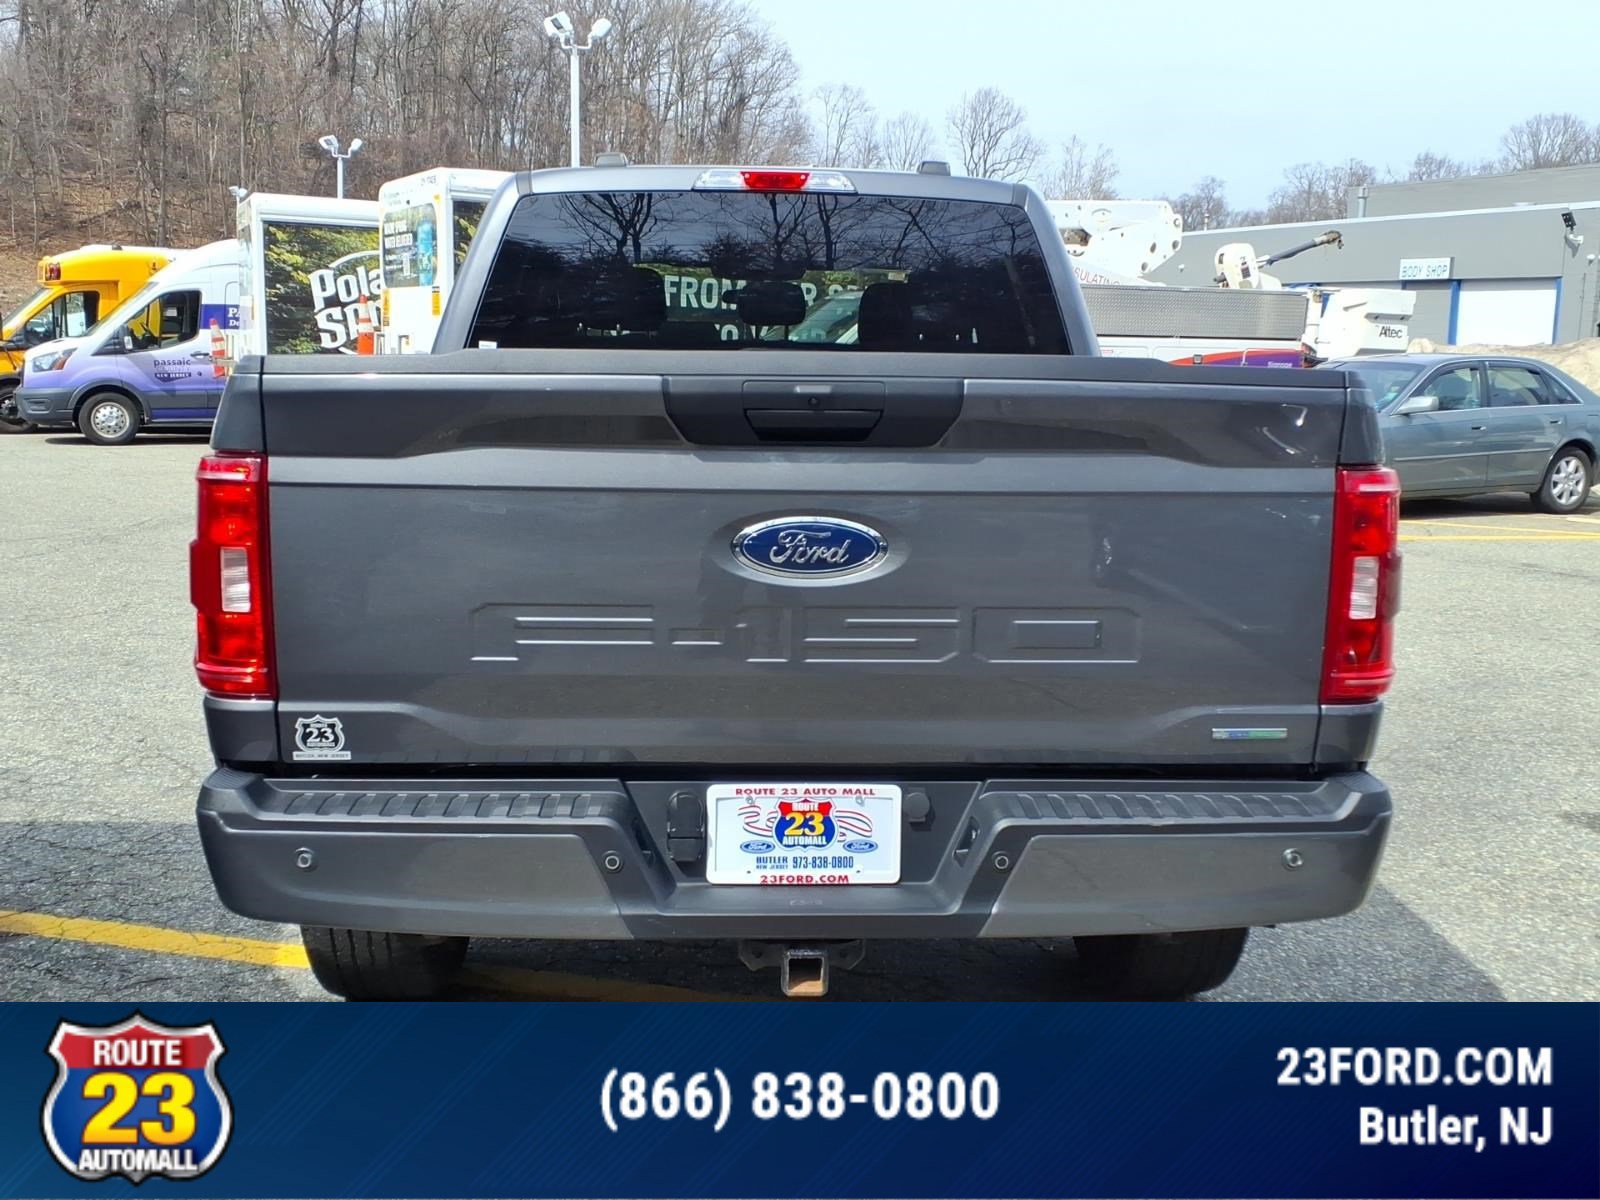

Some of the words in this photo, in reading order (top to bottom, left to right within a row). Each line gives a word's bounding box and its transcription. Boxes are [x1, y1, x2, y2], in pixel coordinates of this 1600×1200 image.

[1401, 265, 1423, 278] BODY
[1426, 264, 1448, 277] SHOP
[1379, 326, 1403, 339] Altec
[153, 357, 192, 367] passaic
[769, 529, 852, 564] Ford
[470, 603, 1142, 664] F-150
[305, 727, 335, 743] 23
[736, 788, 776, 796] ROUTE
[781, 788, 798, 796] 23
[803, 788, 837, 796] AUTO
[842, 788, 876, 796] MALL
[792, 802, 819, 812] ROUTE
[784, 811, 825, 836] 23
[782, 835, 827, 846] AUTOMALL
[756, 856, 788, 864] BUTLER
[792, 856, 854, 869] 973-838-0800
[760, 875, 849, 885] 23FORD.COM
